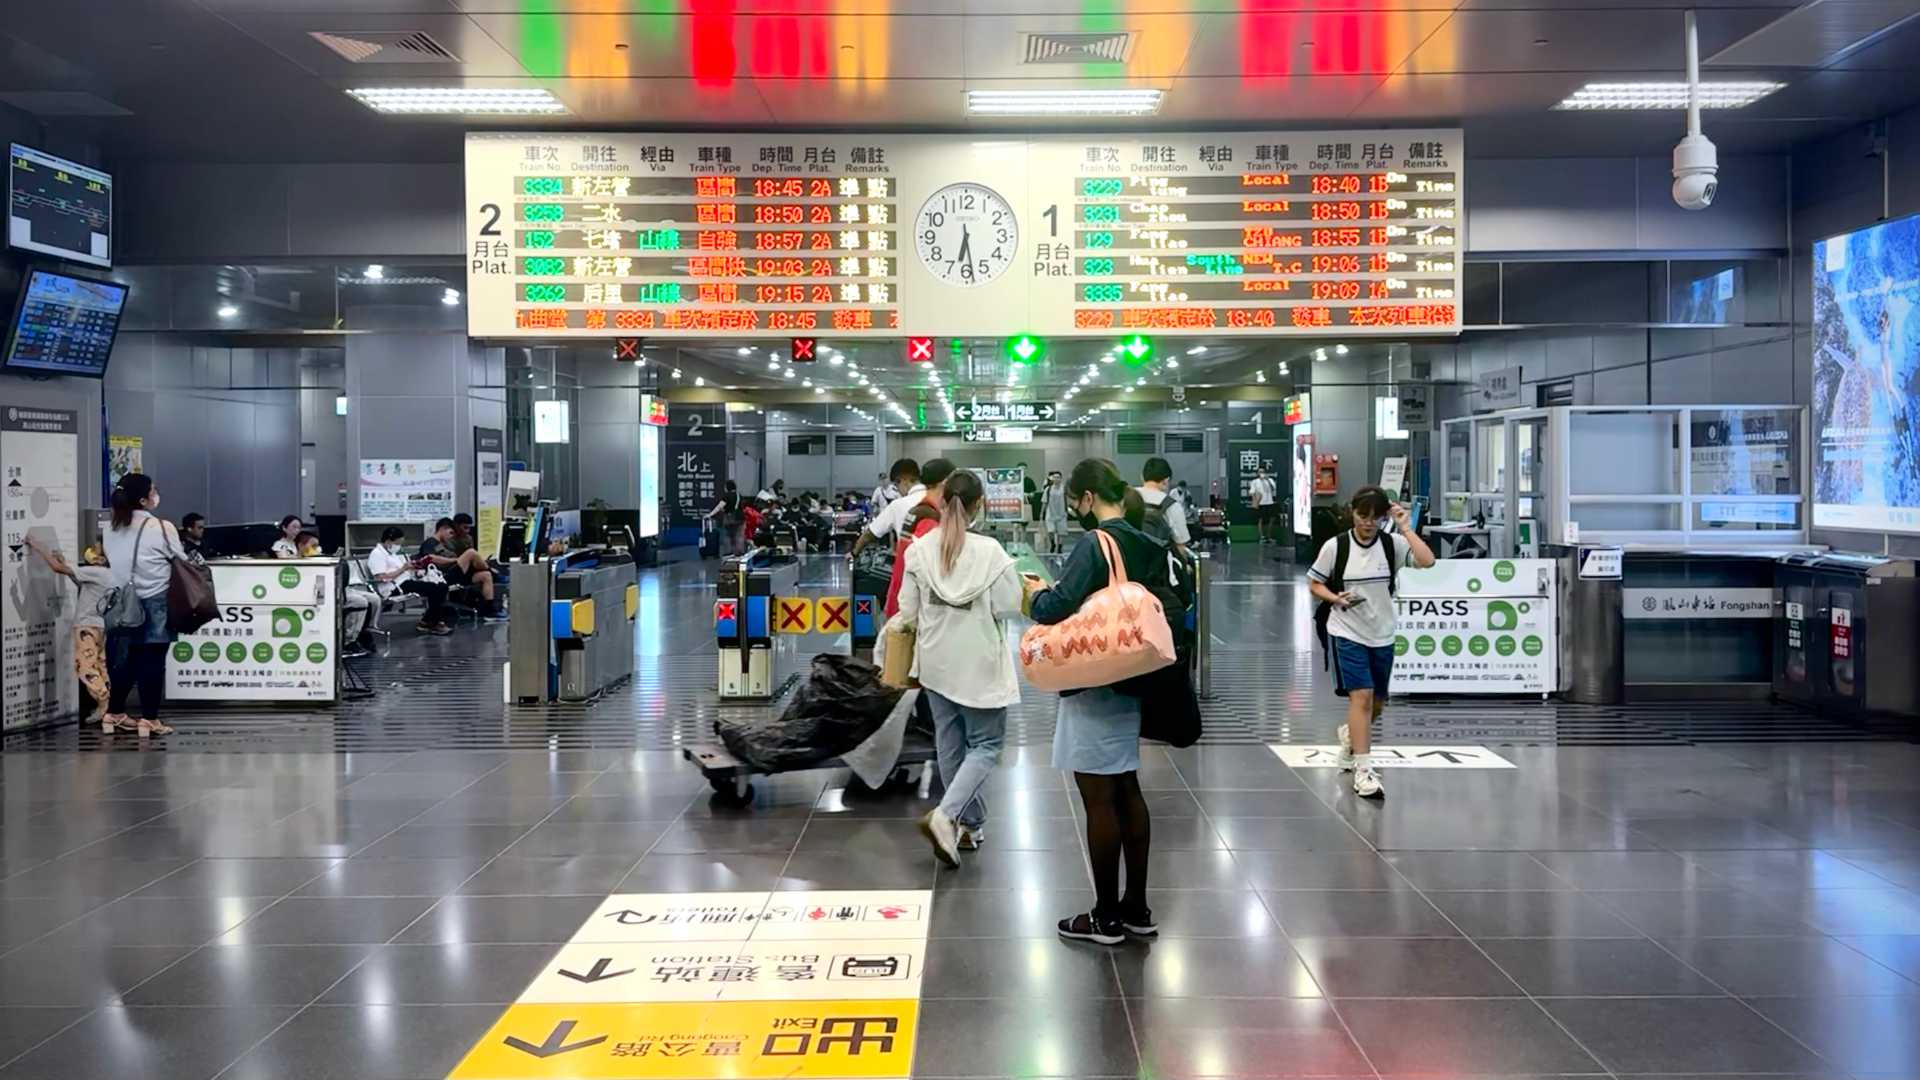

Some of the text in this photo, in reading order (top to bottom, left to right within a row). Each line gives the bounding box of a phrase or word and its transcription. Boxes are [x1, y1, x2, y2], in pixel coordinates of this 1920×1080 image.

[582, 146, 616, 162] 開往
[641, 146, 674, 162] 經由
[698, 147, 732, 163] 車種
[760, 147, 793, 163] 時間
[804, 147, 836, 163] 月台
[851, 147, 884, 164] 備註
[1087, 142, 1443, 162] 車次 開往 經由 車種 時間 月台 備註
[571, 163, 629, 172] Destination
[650, 163, 666, 172] Via
[690, 164, 714, 172] Train
[718, 164, 741, 174] Type
[778, 164, 802, 172] Time
[809, 164, 831, 172] Plat.
[845, 164, 889, 173] Remarks
[1131, 163, 1187, 172] Destination
[1208, 163, 1224, 171] Via
[1247, 162, 1271, 170] Train
[1275, 162, 1298, 172] Type
[1335, 161, 1359, 169] Time
[1366, 160, 1388, 169] Plat.
[1403, 159, 1448, 169] Remarks
[754, 179, 803, 197] 18:45
[810, 179, 832, 197] 2A
[1083, 179, 1123, 196] 3229
[1243, 173, 1290, 185] Local
[1312, 176, 1360, 194] 18:40
[1369, 176, 1388, 194] 1B
[1386, 172, 1408, 183] On
[1416, 181, 1454, 192] Time
[944, 199, 956, 213] 11
[959, 195, 975, 210] 12
[1083, 206, 1120, 223] 3231
[1243, 200, 1290, 211] Local
[1312, 203, 1360, 220] 18:50
[1369, 203, 1388, 220] 1B
[1386, 199, 1408, 210] On
[479, 204, 501, 236] 2
[582, 203, 622, 223] 二水
[754, 206, 803, 223] 18:50
[810, 206, 832, 223] 2A
[929, 211, 944, 227] 10
[992, 210, 1003, 226] 2
[1042, 204, 1058, 237] 1
[1416, 207, 1454, 219] Time
[524, 231, 555, 249] 152
[755, 233, 803, 250] 18:57
[811, 233, 832, 250] 2A
[924, 229, 936, 245] 9
[996, 228, 1008, 244] 3
[1084, 232, 1113, 250] 129
[1312, 230, 1360, 247] 18:55
[1369, 230, 1388, 247] 1B
[1386, 225, 1408, 236] On
[1243, 236, 1302, 248] CHIANG
[1416, 234, 1454, 245] Time
[474, 241, 509, 258] 月台
[931, 246, 942, 262] 8
[991, 246, 1002, 260] 4
[1036, 243, 1070, 260] 月台
[472, 260, 512, 275] Plat.
[755, 260, 804, 277] 19:03
[811, 260, 832, 277] 2A
[945, 260, 955, 275] 7
[960, 264, 973, 279] 6
[978, 259, 990, 274] 5
[1034, 262, 1073, 276] Plat.
[1084, 259, 1114, 276] 323
[1186, 254, 1236, 265] South
[1243, 253, 1273, 264] NEW
[1312, 256, 1360, 273] 19:06
[1369, 256, 1388, 273] 1B
[1386, 252, 1408, 263] On
[1205, 264, 1244, 275] Line
[1416, 261, 1454, 272] Time
[526, 285, 565, 302] 3262
[583, 284, 624, 304] 后里
[756, 286, 805, 303] 19:15
[812, 286, 833, 303] 2A
[1083, 285, 1123, 302] 3335
[1243, 279, 1290, 291] Local
[1312, 283, 1360, 300] 19:09
[1369, 283, 1388, 300] 1A
[1386, 279, 1408, 289] On
[1416, 287, 1453, 299] Time
[615, 311, 654, 329] 3334
[767, 311, 817, 329] 18:45
[1075, 311, 1114, 329] 3229
[1226, 309, 1275, 328] 18:40
[688, 414, 703, 436] 2
[1250, 412, 1262, 434] 1
[677, 451, 711, 472] 北上
[1240, 450, 1273, 470] 南下
[1393, 599, 1468, 617] TPASS
[1720, 601, 1770, 612] Fongshan
[651, 955, 754, 965] Station
[650, 965, 817, 983] 客運站
[773, 1017, 817, 1028] Exit
[761, 1016, 899, 1057] 出口
[612, 1040, 743, 1057] 曹公路
